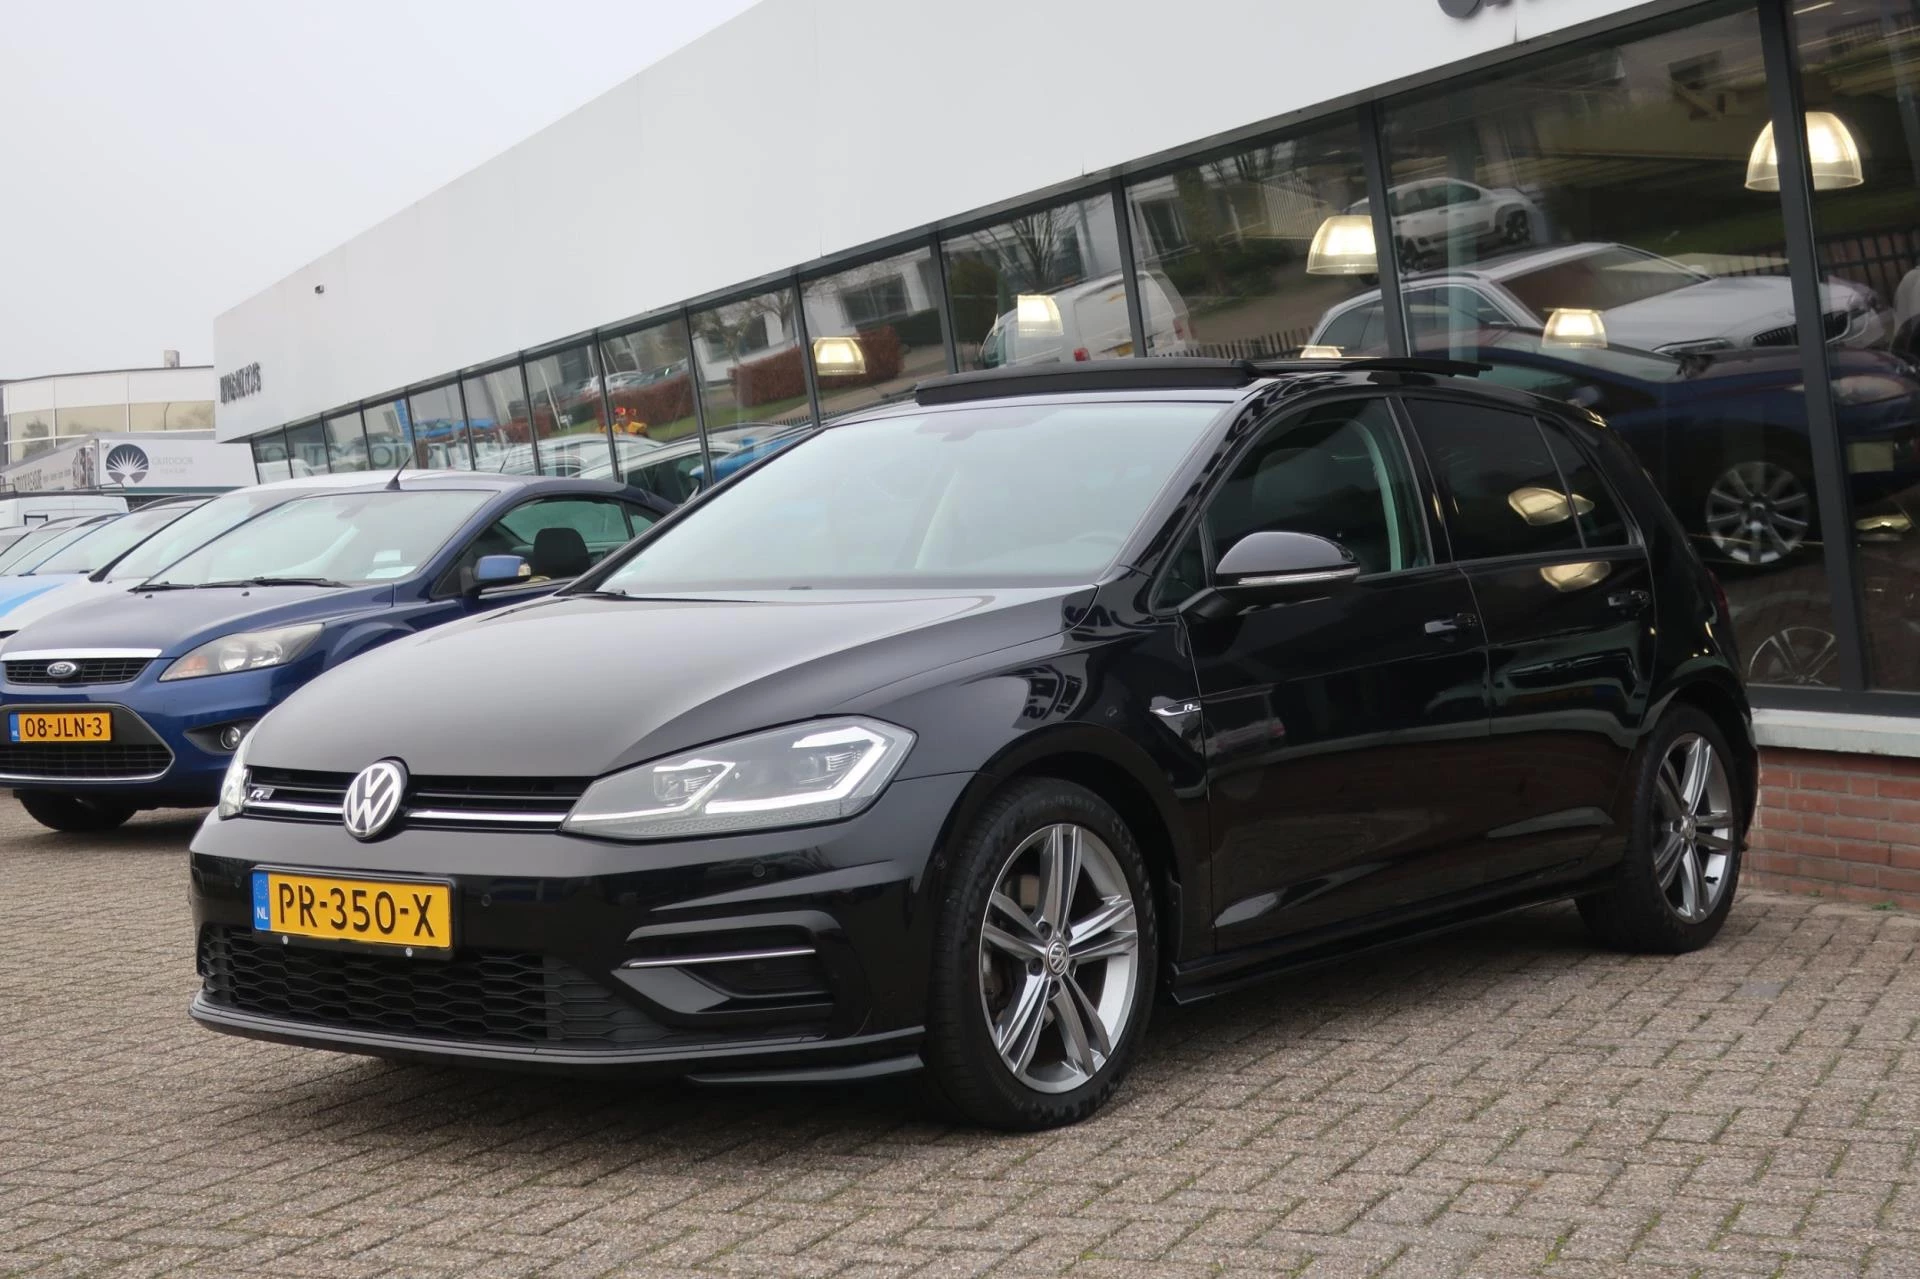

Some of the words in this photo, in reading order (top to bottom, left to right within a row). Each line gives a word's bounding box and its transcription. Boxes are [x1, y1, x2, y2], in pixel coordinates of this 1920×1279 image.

[25, 717, 103, 738] 08-JLN-3
[256, 906, 269, 921] NL
[278, 882, 436, 938] PR-350-X
